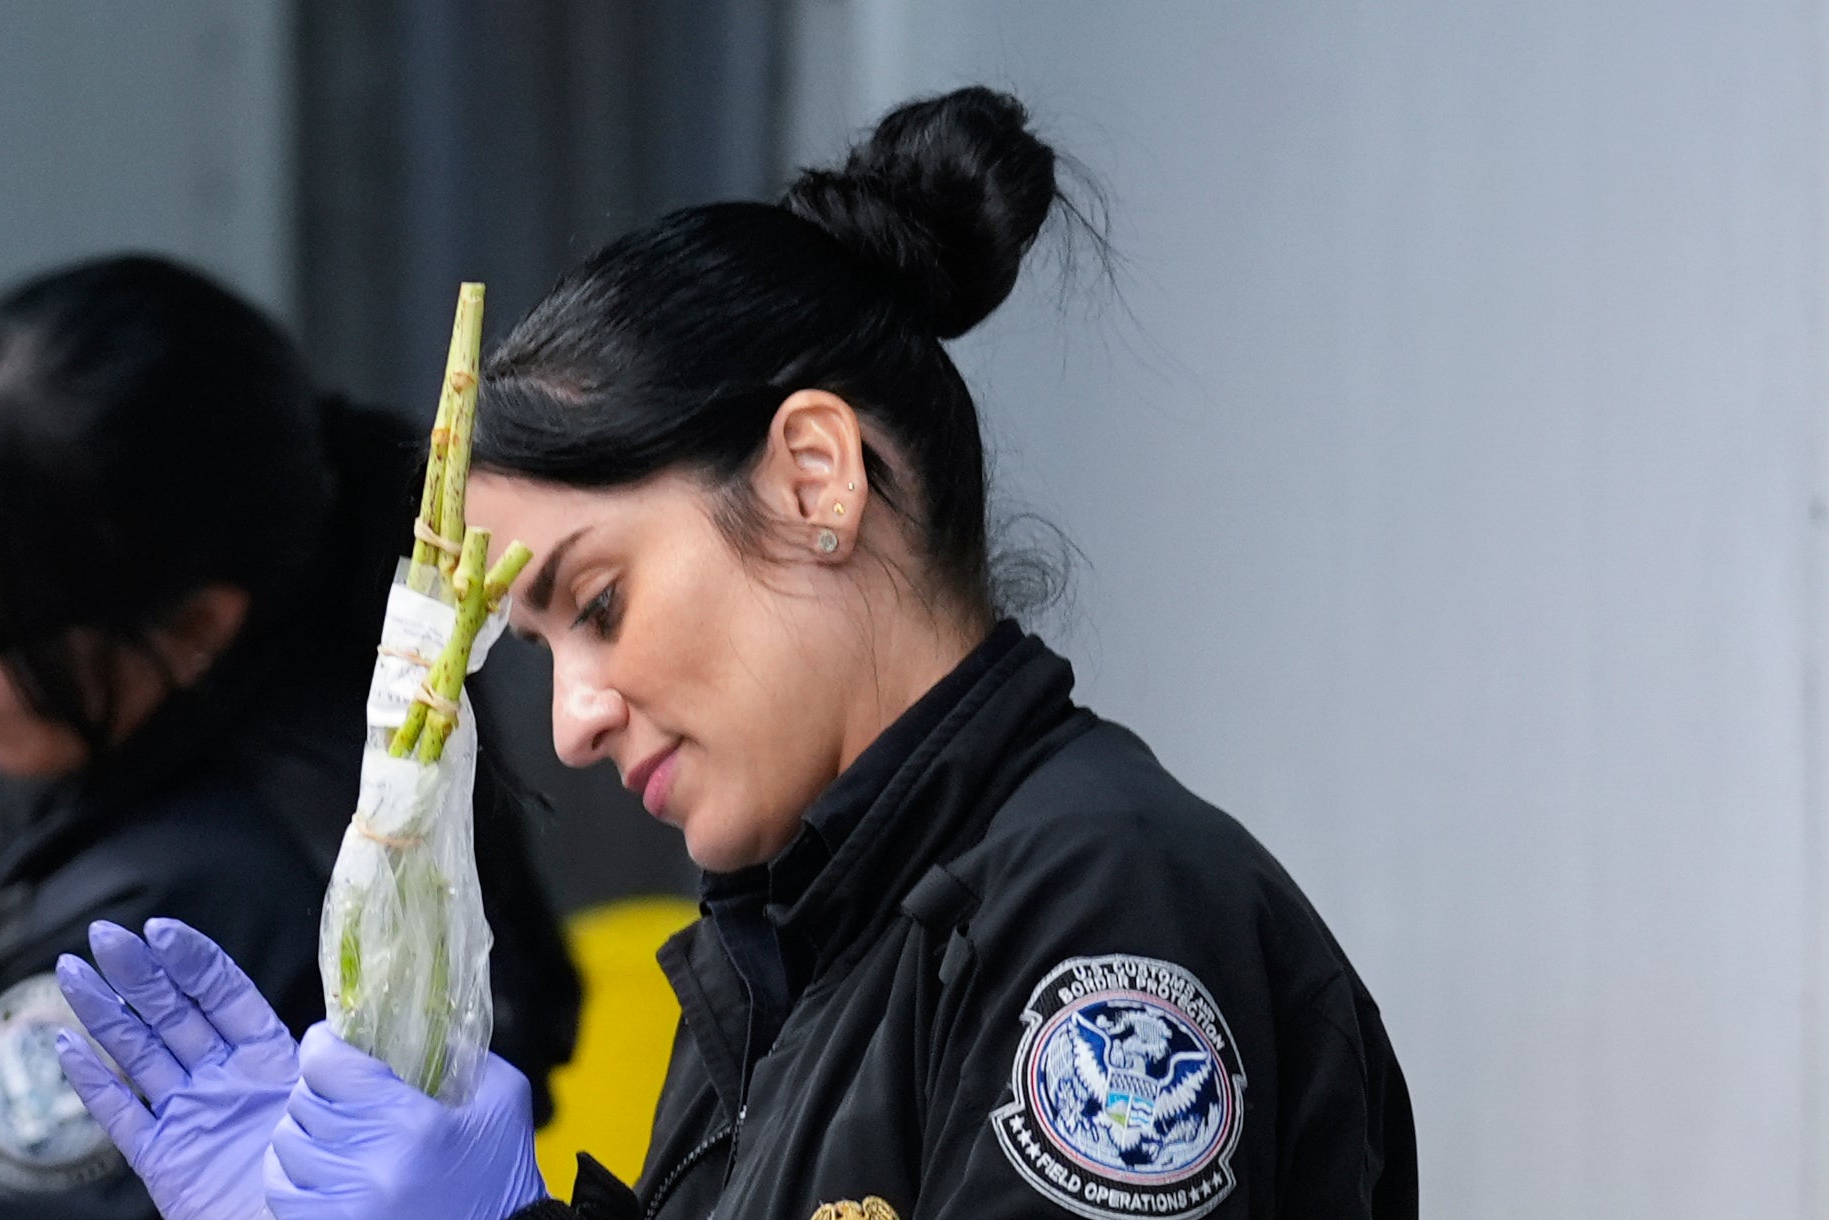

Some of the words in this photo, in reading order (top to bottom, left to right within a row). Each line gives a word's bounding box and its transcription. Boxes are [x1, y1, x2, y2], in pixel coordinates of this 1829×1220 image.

[1058, 974, 1129, 1004] BORDER
[1136, 977, 1225, 1050] PROTECTION
[1113, 960, 1195, 998] CUSTOMS
[1194, 997, 1216, 1023] AND
[1036, 1153, 1081, 1193] FIELD
[1084, 1182, 1187, 1212] OPERATIONS
